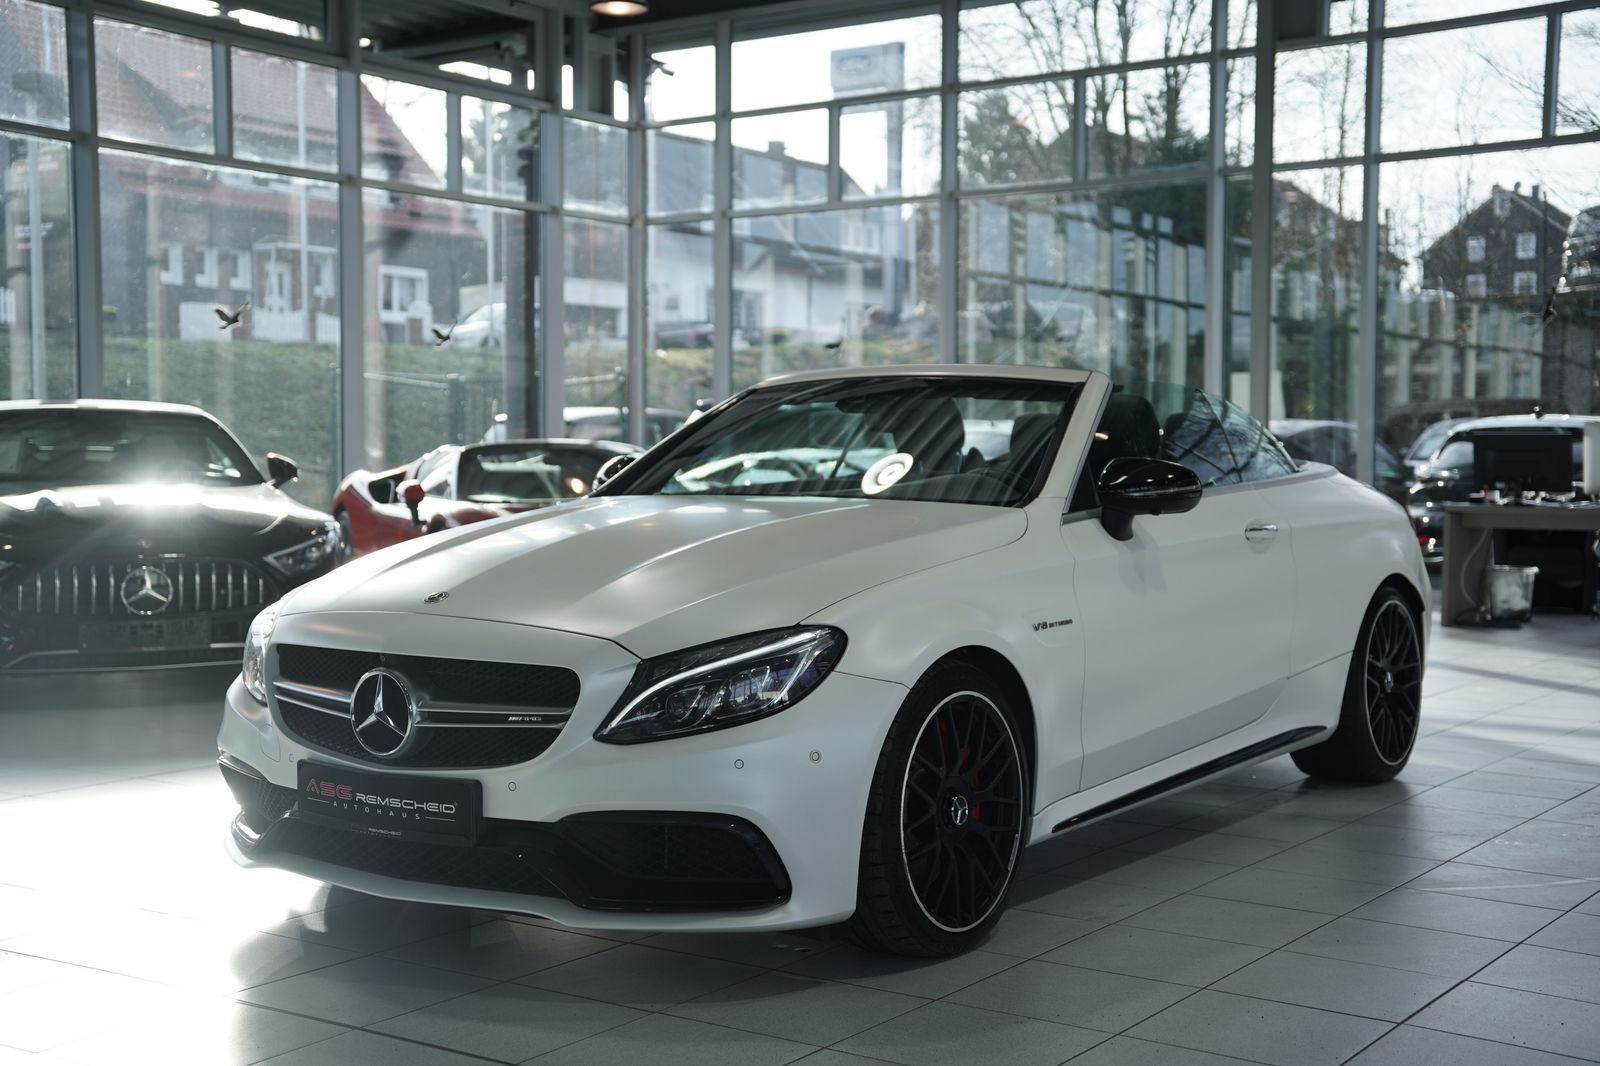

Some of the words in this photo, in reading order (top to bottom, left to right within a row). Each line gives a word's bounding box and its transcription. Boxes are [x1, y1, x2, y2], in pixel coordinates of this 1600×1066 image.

[1032, 621, 1048, 631] V8
[306, 778, 353, 800] ASG
[355, 792, 456, 814] REMSCHEID
[333, 801, 421, 820] AUTOHAUS
